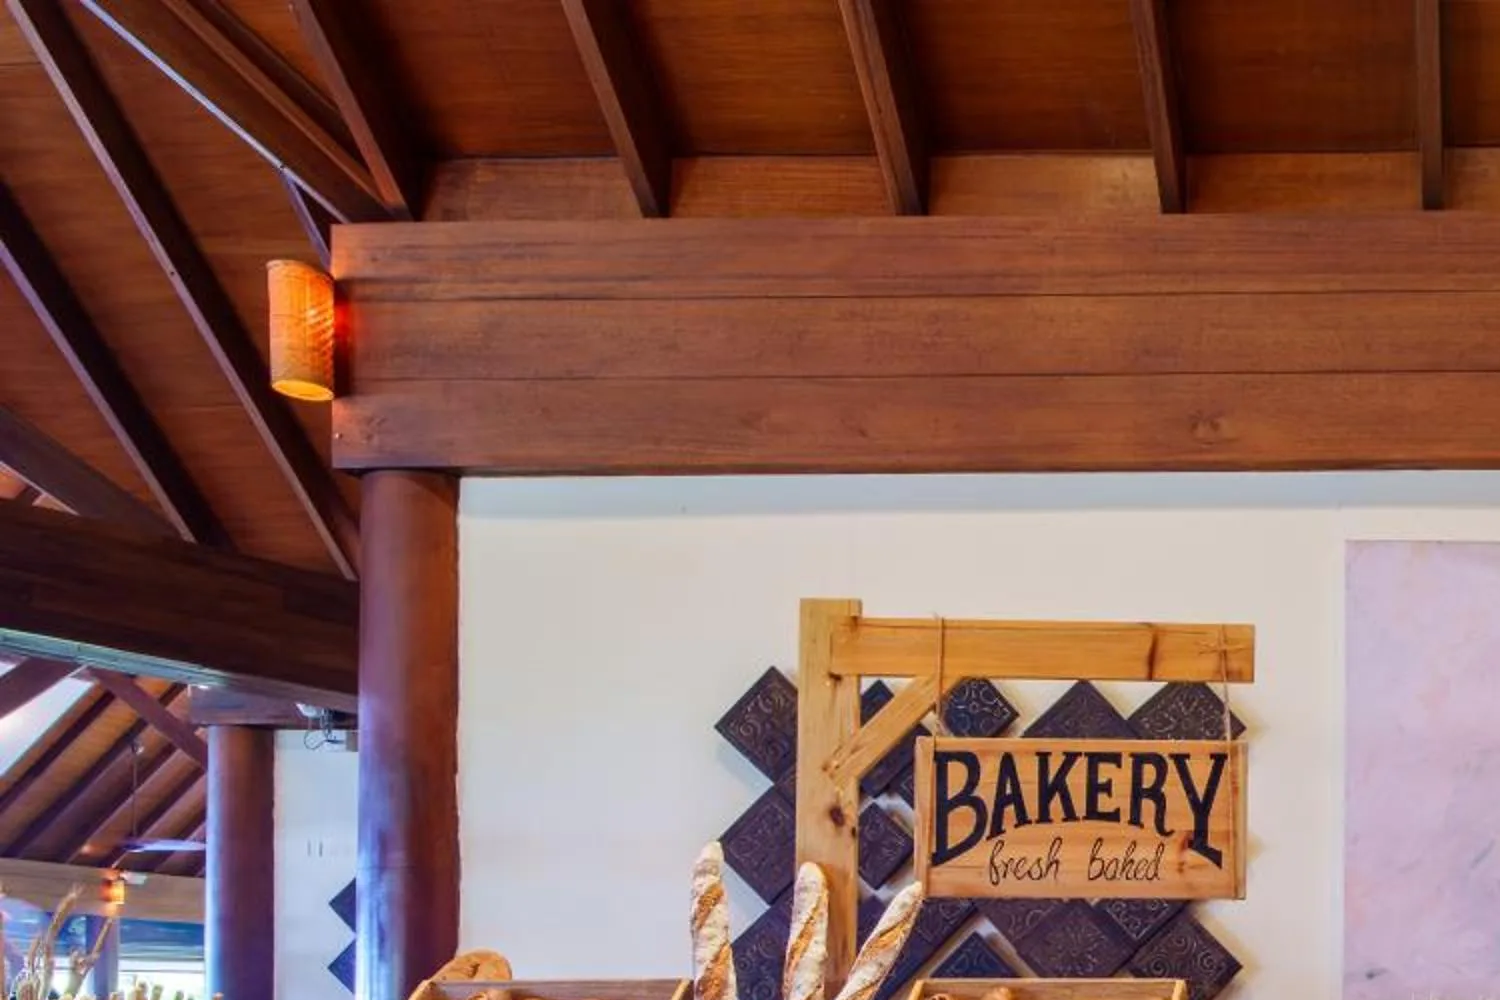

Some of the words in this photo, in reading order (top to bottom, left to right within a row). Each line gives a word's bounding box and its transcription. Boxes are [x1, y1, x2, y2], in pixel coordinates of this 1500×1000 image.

[931, 751, 1228, 870] BAKERY
[985, 836, 1064, 886] fresh
[1087, 836, 1165, 882] baked
